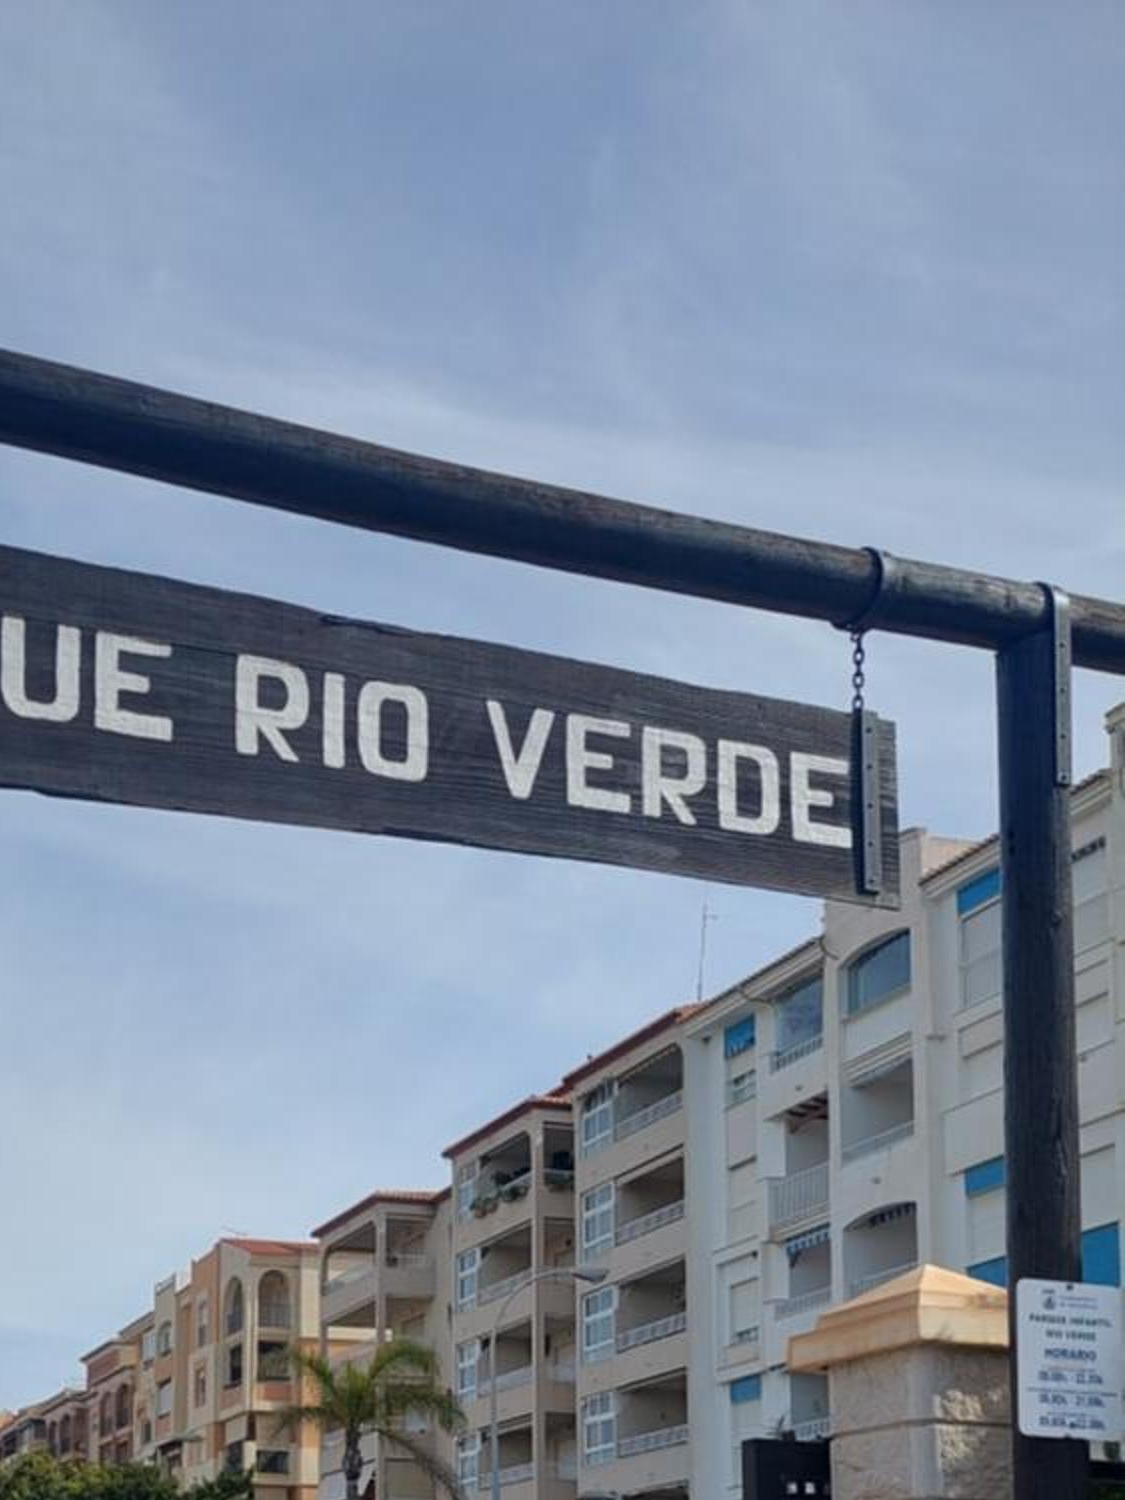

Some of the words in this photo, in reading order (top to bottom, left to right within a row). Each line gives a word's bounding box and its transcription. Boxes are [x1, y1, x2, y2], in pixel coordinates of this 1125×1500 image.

[235, 653, 429, 783] RIO
[486, 700, 852, 850] VERDE
[1029, 1313, 1066, 1325] PARQUE
[1070, 1317, 1113, 1328] INFANTIL
[1044, 1348, 1097, 1361] HORARIO
